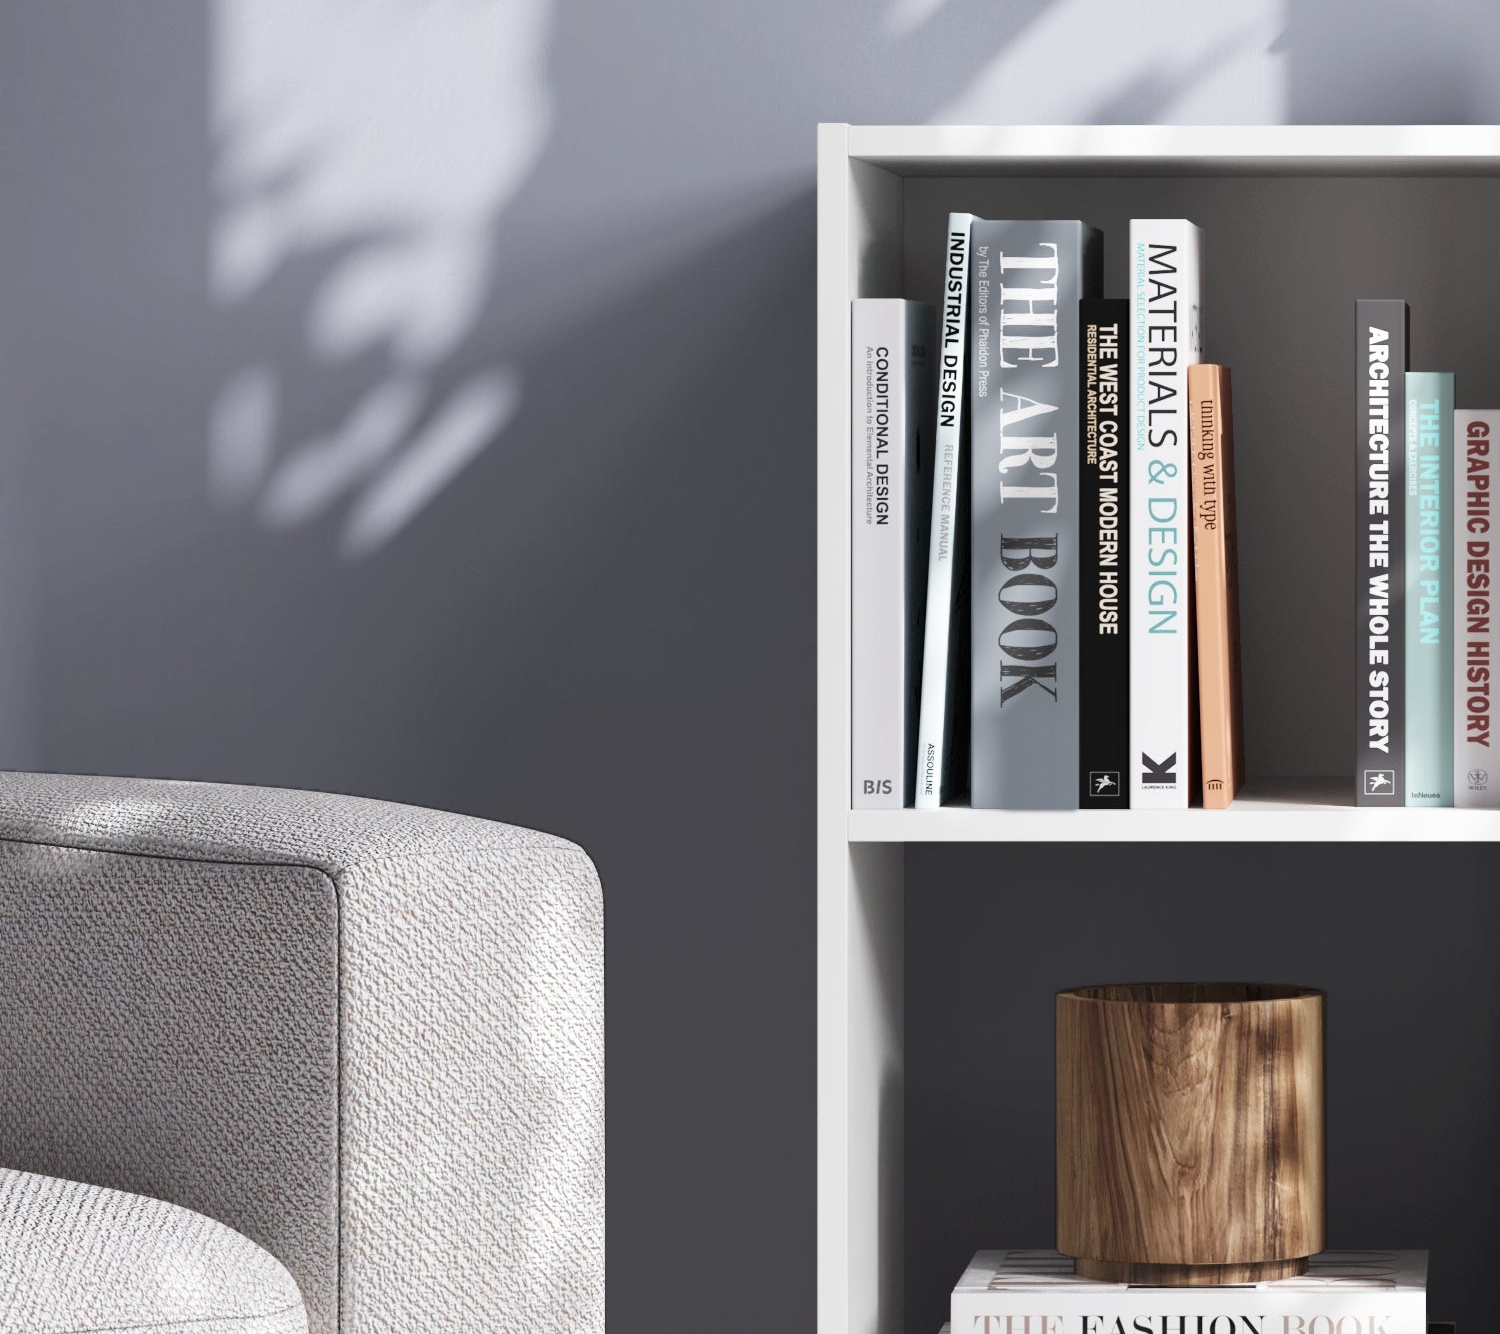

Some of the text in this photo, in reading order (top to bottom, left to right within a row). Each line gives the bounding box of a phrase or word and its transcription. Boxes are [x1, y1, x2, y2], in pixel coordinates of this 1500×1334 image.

[867, 347, 874, 358] An
[941, 233, 965, 426] INDUSTRIAL DESIGN
[977, 247, 989, 397] by The Editors of Phaidon Press
[1087, 324, 1097, 464] RESIDENTIAL ARCHITECTURE
[1137, 243, 1145, 450] MATERIAL SELECTION FOR PRODUCT DESIGN
[867, 416, 874, 424] to
[876, 347, 888, 524] CONDITIONAL DESIGN
[998, 243, 1059, 708] THE ART BOOK
[1099, 324, 1118, 634] THE WEST COAST MODERN HOUSE
[1148, 244, 1177, 633] MATERIALS & DESIGN
[1199, 400, 1216, 529] thinking with type
[1409, 399, 1418, 442] CONCEPTS
[1409, 452, 1418, 496] EXERCISES
[938, 444, 954, 561] REFERENCE MANUAL
[1369, 327, 1389, 753] ARCHITECTURE THE WHOLE STORY
[1420, 399, 1440, 644] THE INTERIOR PLAN
[1467, 421, 1489, 746] GRAPHIC DESIGN HISTORY
[864, 780, 892, 794] BIS
[926, 744, 934, 795] ASSOULINE
